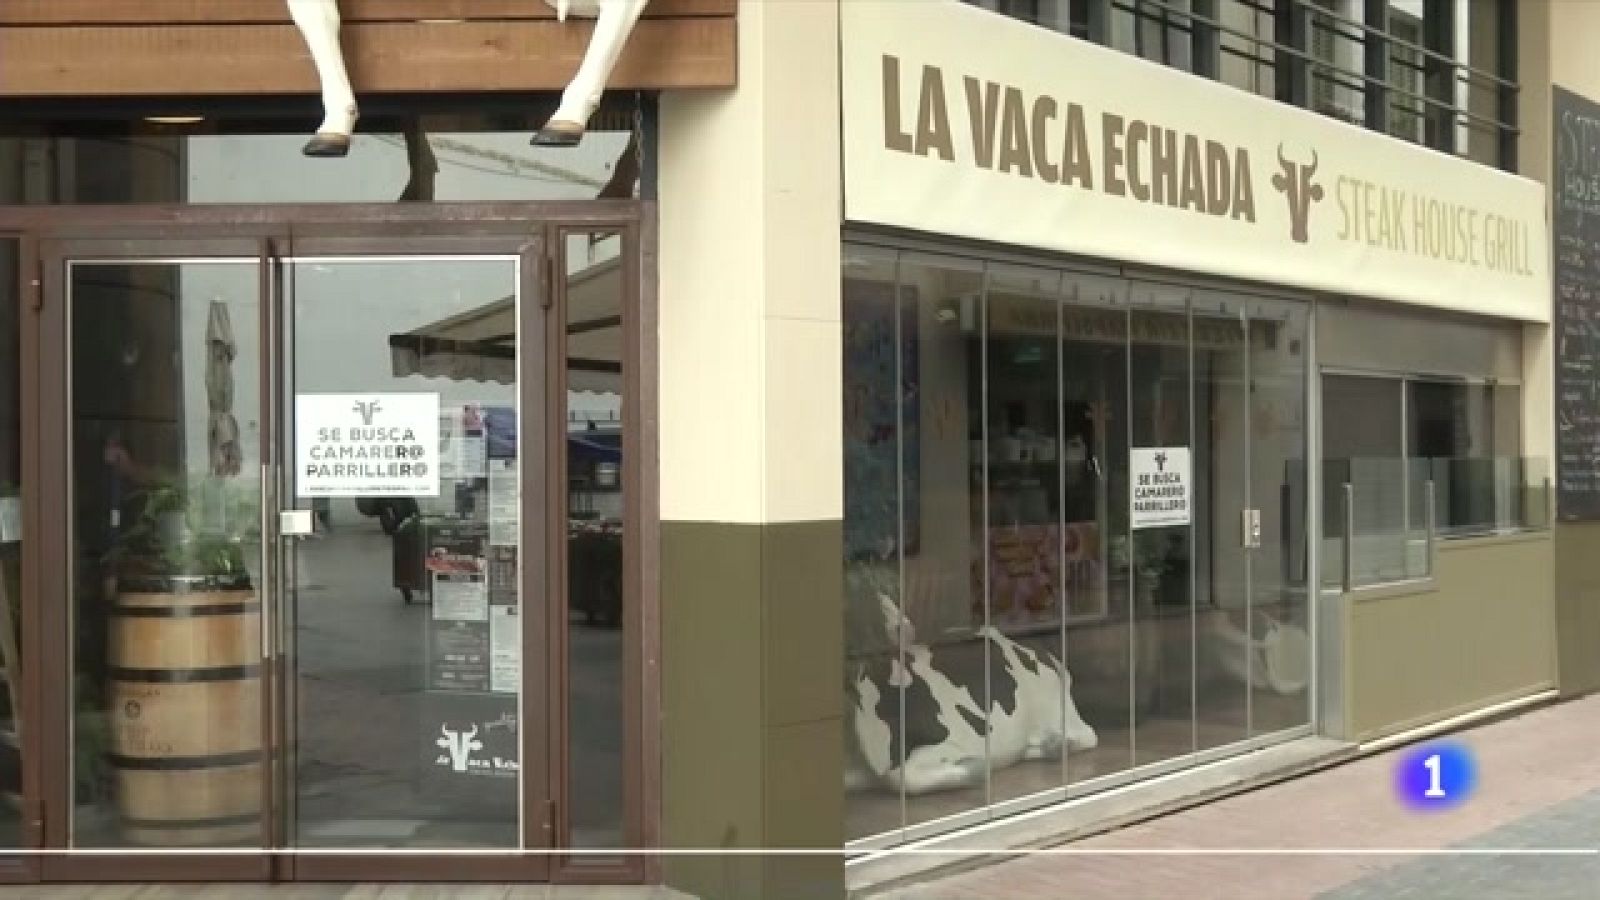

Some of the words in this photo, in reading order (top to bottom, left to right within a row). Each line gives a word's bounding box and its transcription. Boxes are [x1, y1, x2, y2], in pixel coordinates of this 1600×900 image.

[882, 53, 955, 162] LA
[962, 74, 1093, 190] VACA
[1101, 111, 1256, 223] ECHADA
[1335, 174, 1407, 251] STEAK
[1412, 192, 1481, 265] HOUSE
[1484, 212, 1534, 276] GRILL
[317, 426, 341, 442] SE
[349, 426, 415, 442] BUSCA
[1138, 473, 1151, 485] SE
[1152, 472, 1181, 485] BUSCA
